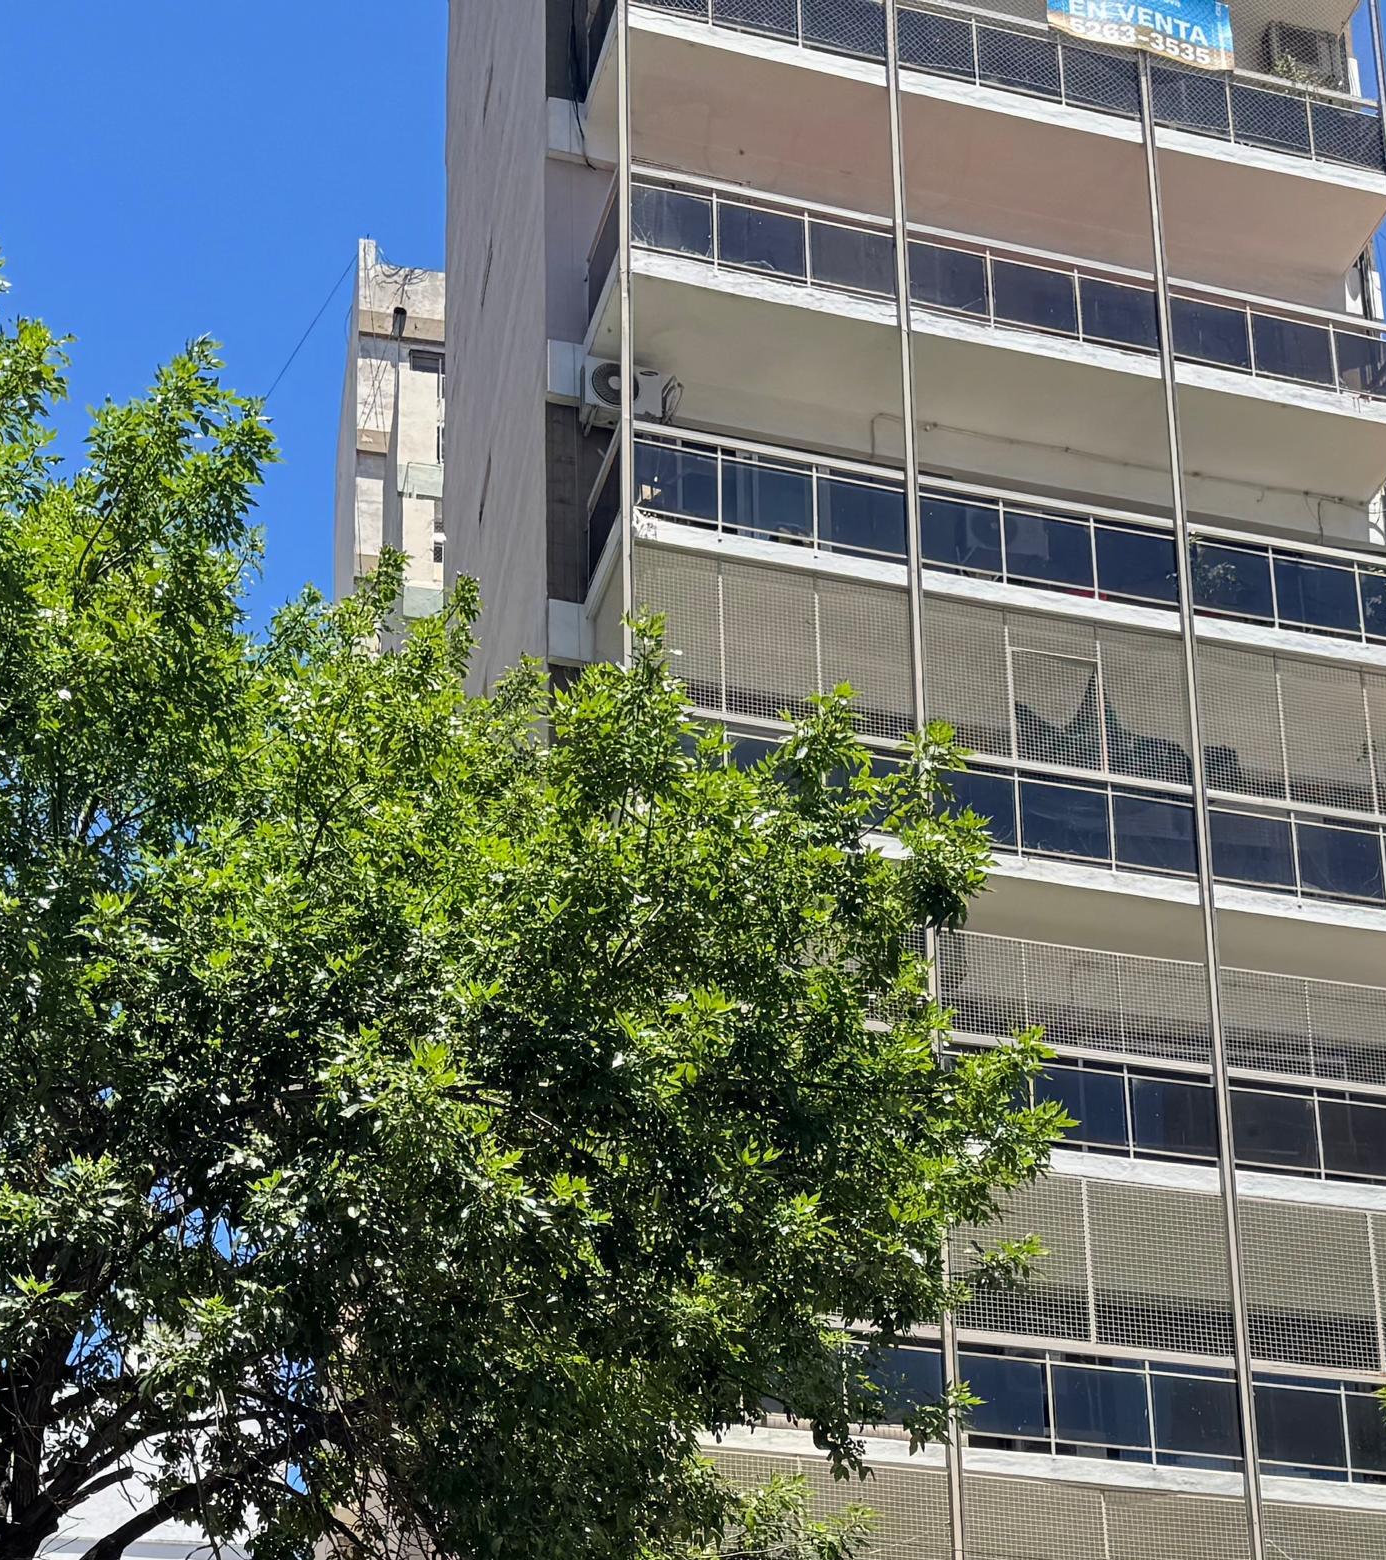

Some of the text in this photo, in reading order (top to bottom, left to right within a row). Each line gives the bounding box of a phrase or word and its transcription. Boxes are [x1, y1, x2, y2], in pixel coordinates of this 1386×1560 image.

[1069, 0, 1108, 19] EN
[1119, 3, 1208, 45] VENTA
[1069, 18, 1212, 65] 5263-3535
